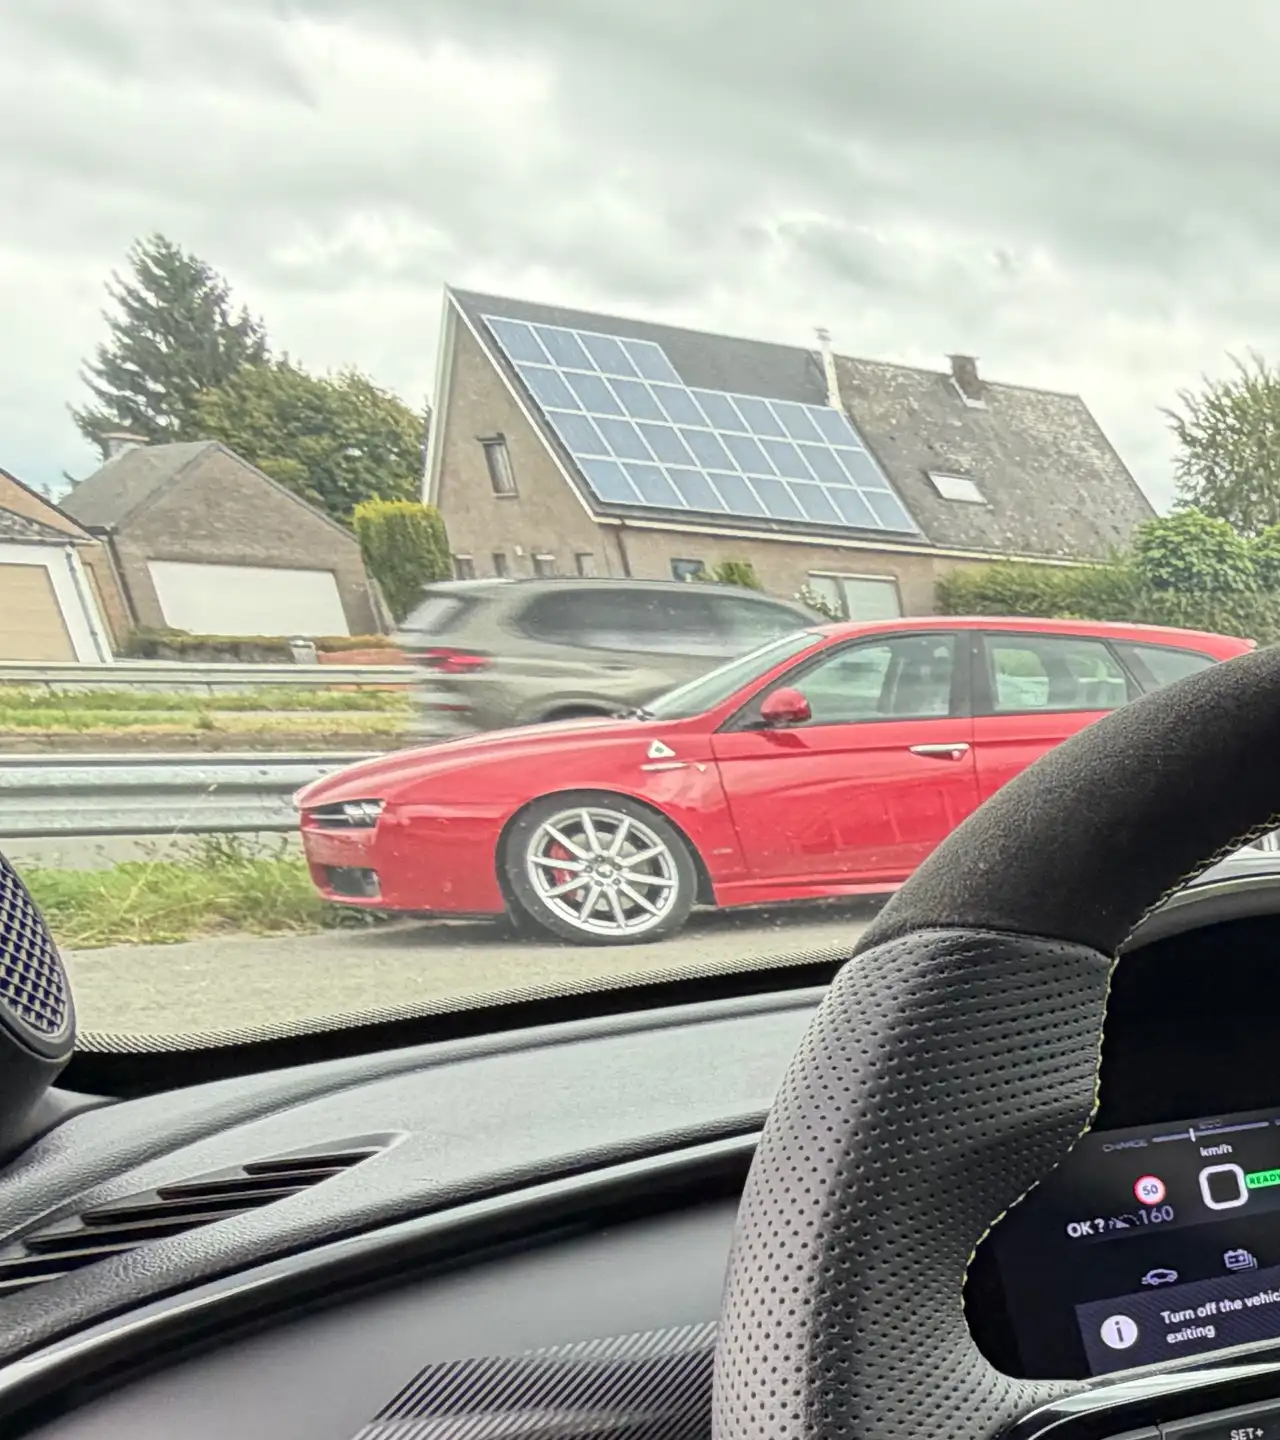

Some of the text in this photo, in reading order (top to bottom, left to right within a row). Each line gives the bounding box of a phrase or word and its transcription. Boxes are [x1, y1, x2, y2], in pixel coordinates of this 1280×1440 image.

[1199, 1143, 1233, 1157] km/h
[1142, 1183, 1159, 1197] 50
[1138, 1205, 1174, 1226] 160
[1160, 1309, 1195, 1325] Turn
[1196, 1301, 1217, 1318] off
[1219, 1298, 1243, 1314] the
[1166, 1325, 1216, 1344] exiting
